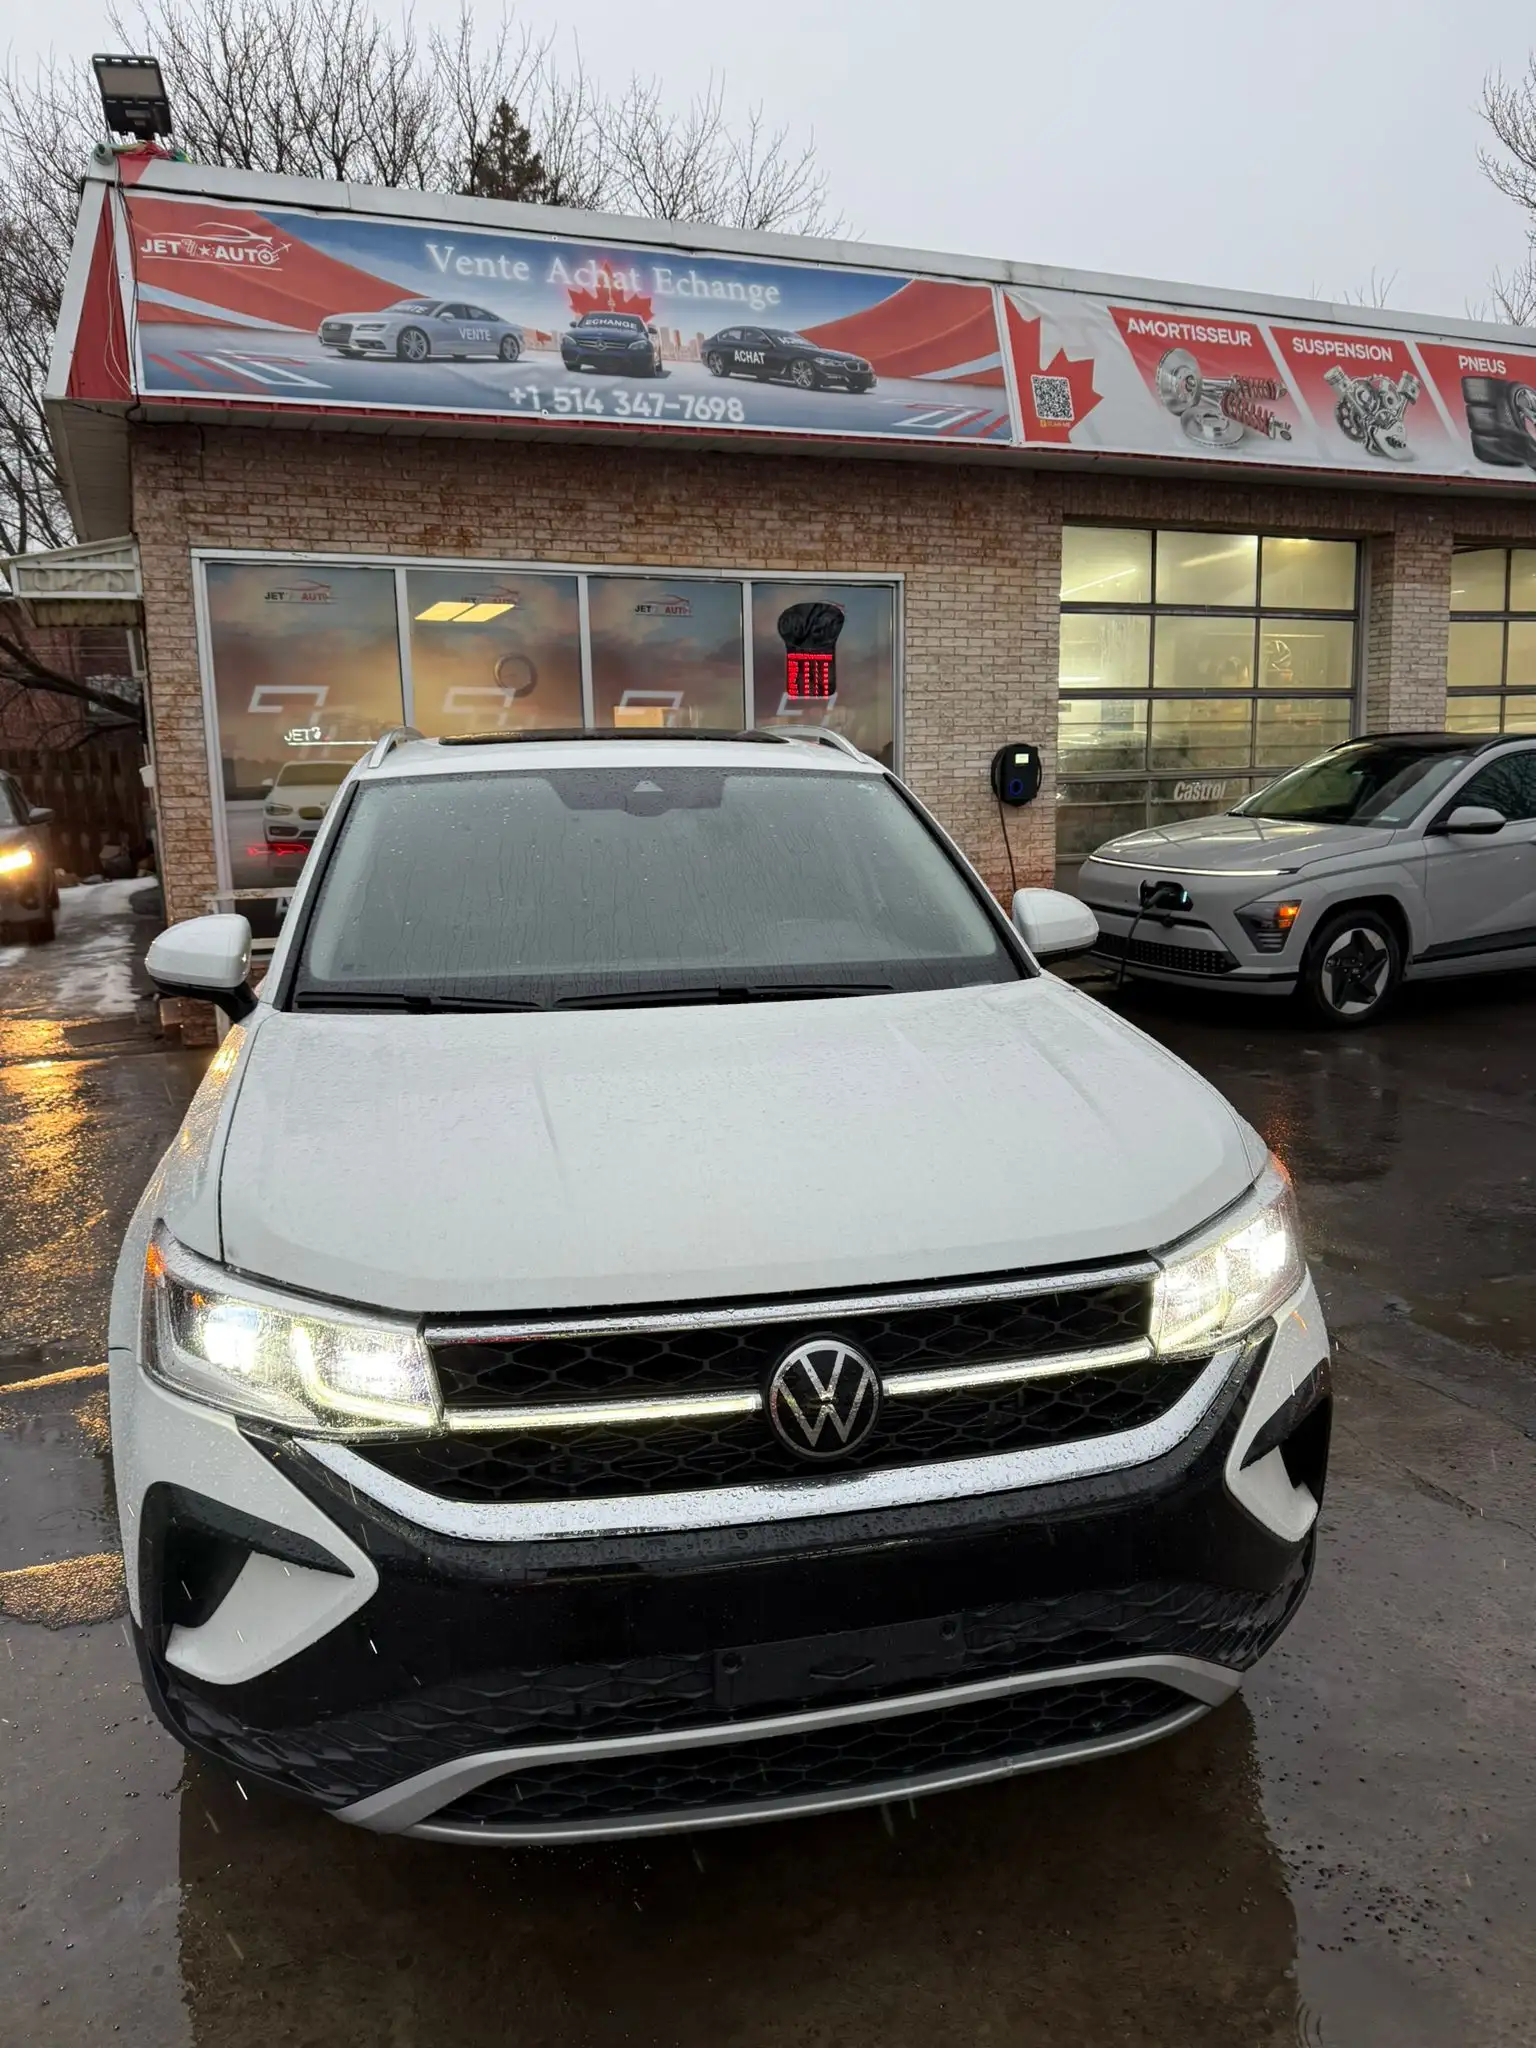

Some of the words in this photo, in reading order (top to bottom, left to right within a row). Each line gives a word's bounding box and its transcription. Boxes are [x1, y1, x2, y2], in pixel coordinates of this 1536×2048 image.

[140, 239, 181, 255] JET
[425, 243, 530, 282] Vente
[547, 256, 642, 292] Achat
[652, 266, 781, 312] Echange
[585, 317, 638, 330] ECHANGE
[1127, 317, 1253, 348] AMORTISSEUR
[459, 327, 492, 341] VENTE
[734, 349, 767, 365] ACHAT
[1292, 337, 1394, 362] SUSPENSION
[1458, 355, 1507, 375] PNEUS
[509, 385, 541, 410] +1
[553, 387, 604, 414] 514
[612, 390, 745, 423] 347-7698
[1174, 781, 1227, 801] Castrol
[770, 1340, 880, 1457] VW
